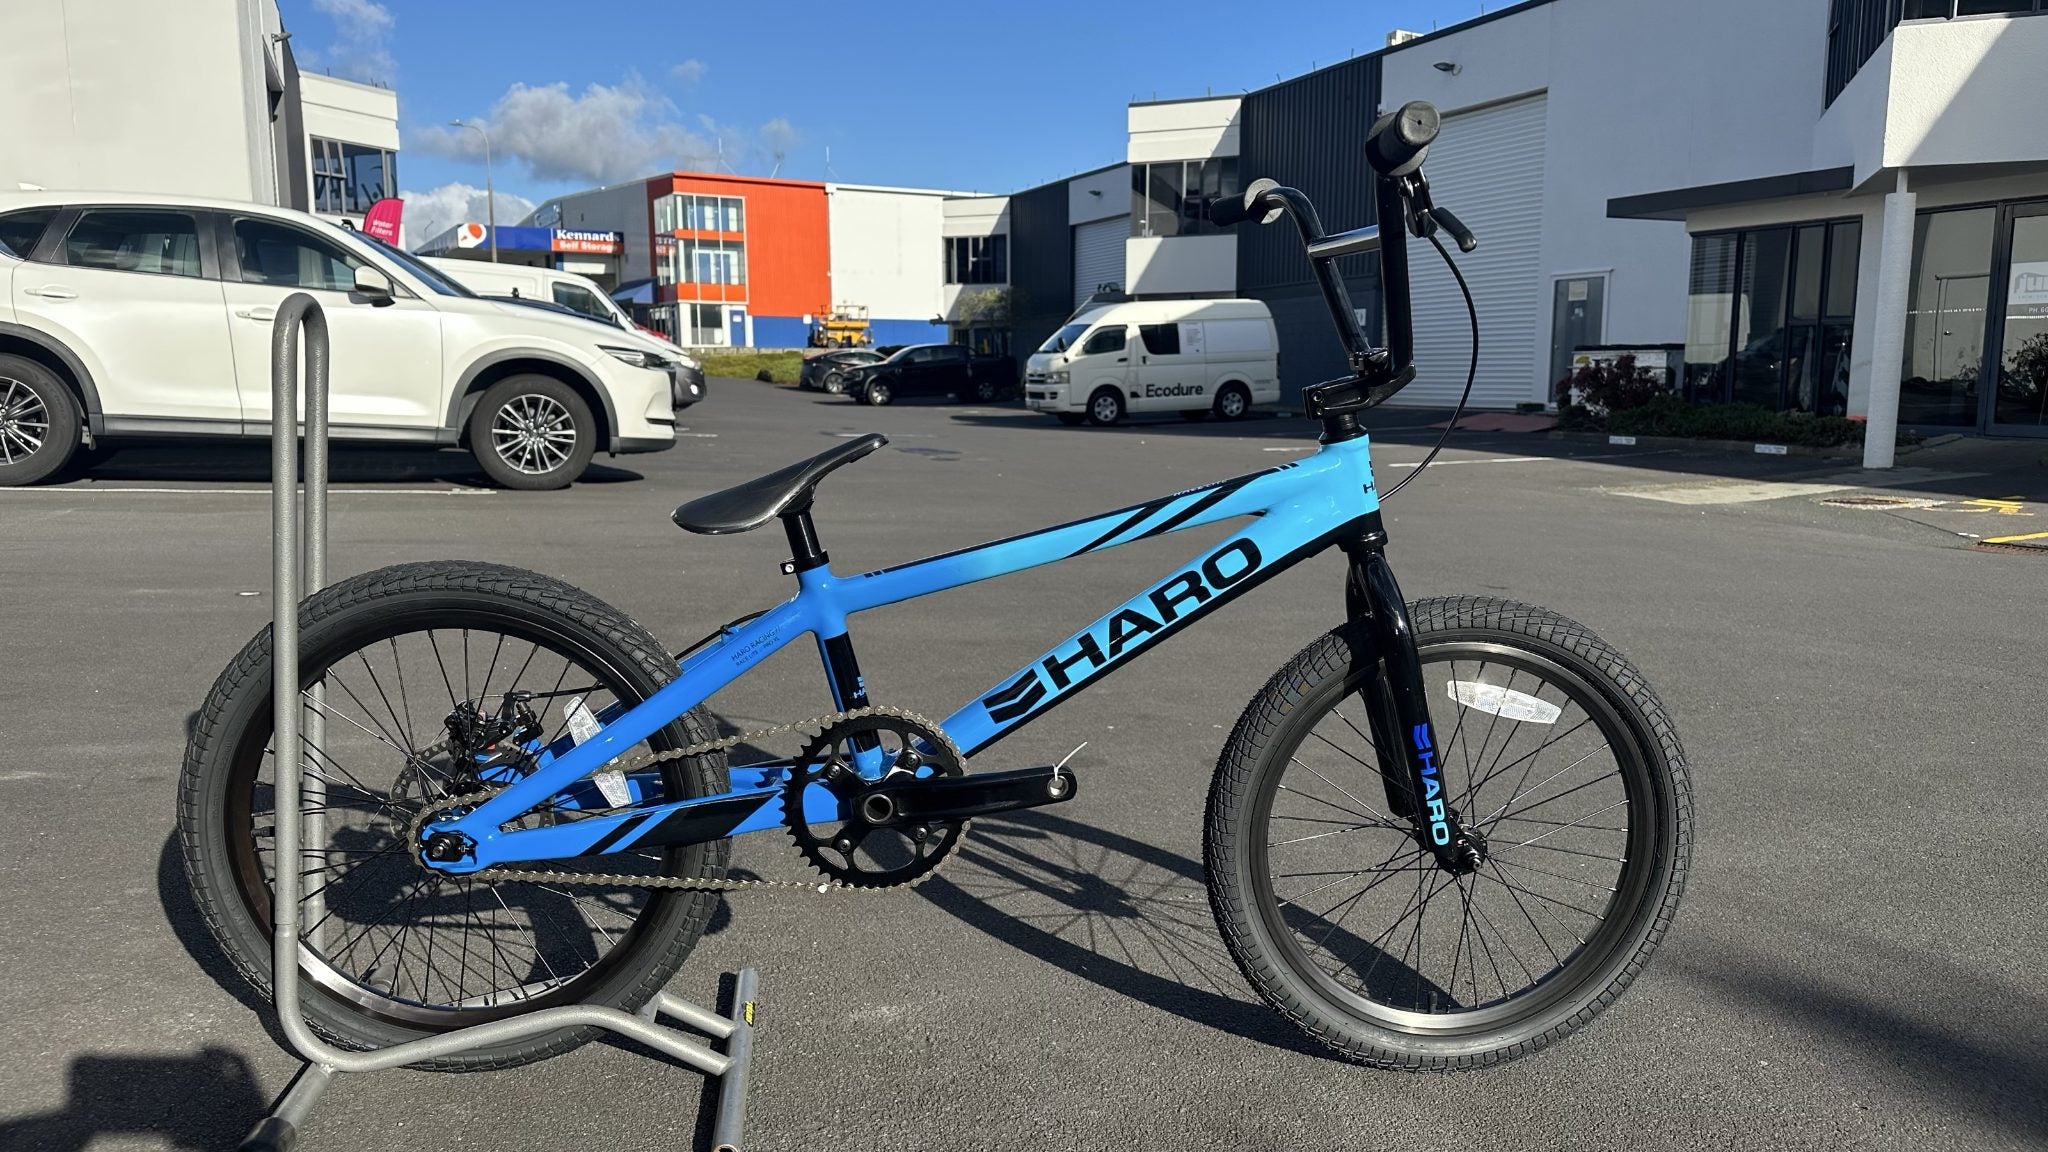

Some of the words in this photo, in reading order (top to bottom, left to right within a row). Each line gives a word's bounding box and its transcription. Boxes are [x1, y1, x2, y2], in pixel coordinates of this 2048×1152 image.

[560, 240, 579, 250] Self
[1145, 382, 1204, 398] Ecodure
[1042, 537, 1262, 691] HARO
[731, 645, 751, 661] HARO
[1417, 750, 1450, 846] HARO
